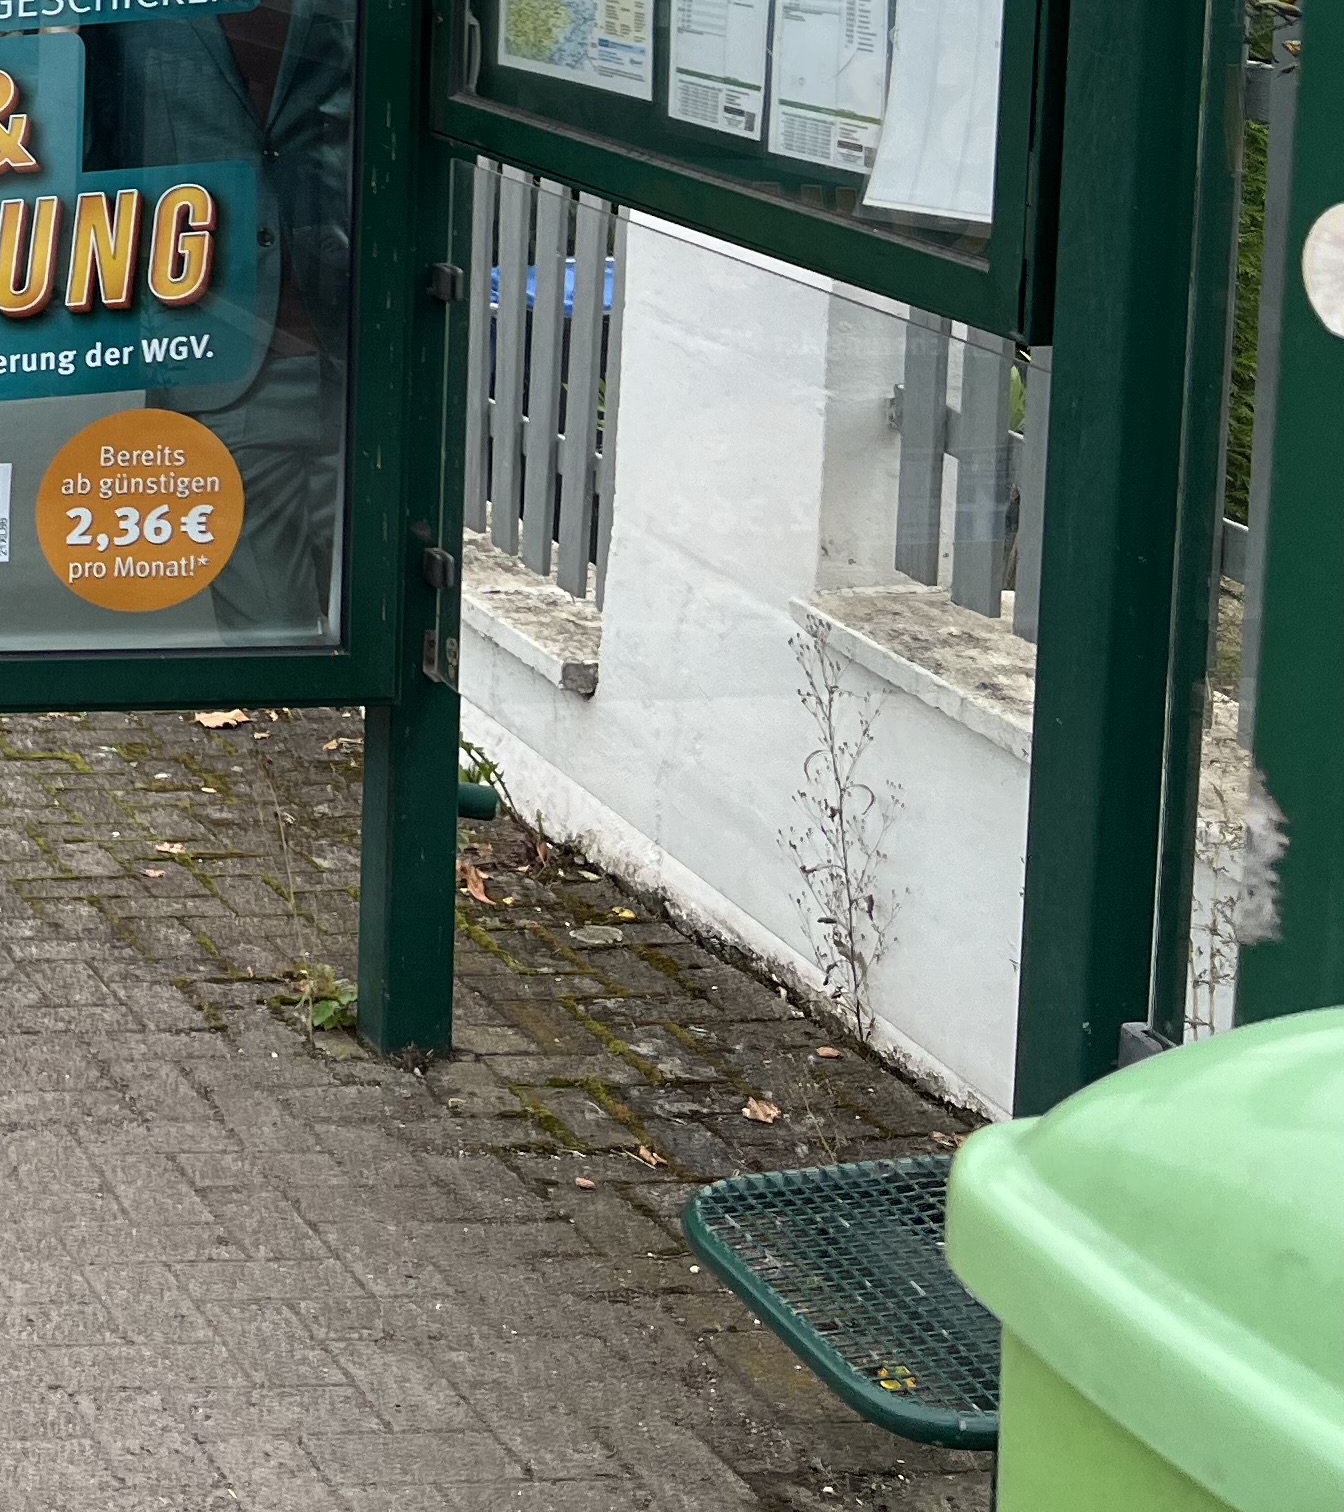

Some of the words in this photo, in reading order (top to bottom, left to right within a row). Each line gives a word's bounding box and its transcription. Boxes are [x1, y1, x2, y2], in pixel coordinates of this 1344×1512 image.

[85, 341, 134, 368] der
[141, 334, 214, 363] WGV.
[100, 444, 186, 467] Bereits
[61, 473, 91, 495] ab
[99, 471, 220, 499] günstigen
[65, 504, 172, 552] 2,36
[180, 504, 215, 544] €
[68, 562, 107, 584] pro
